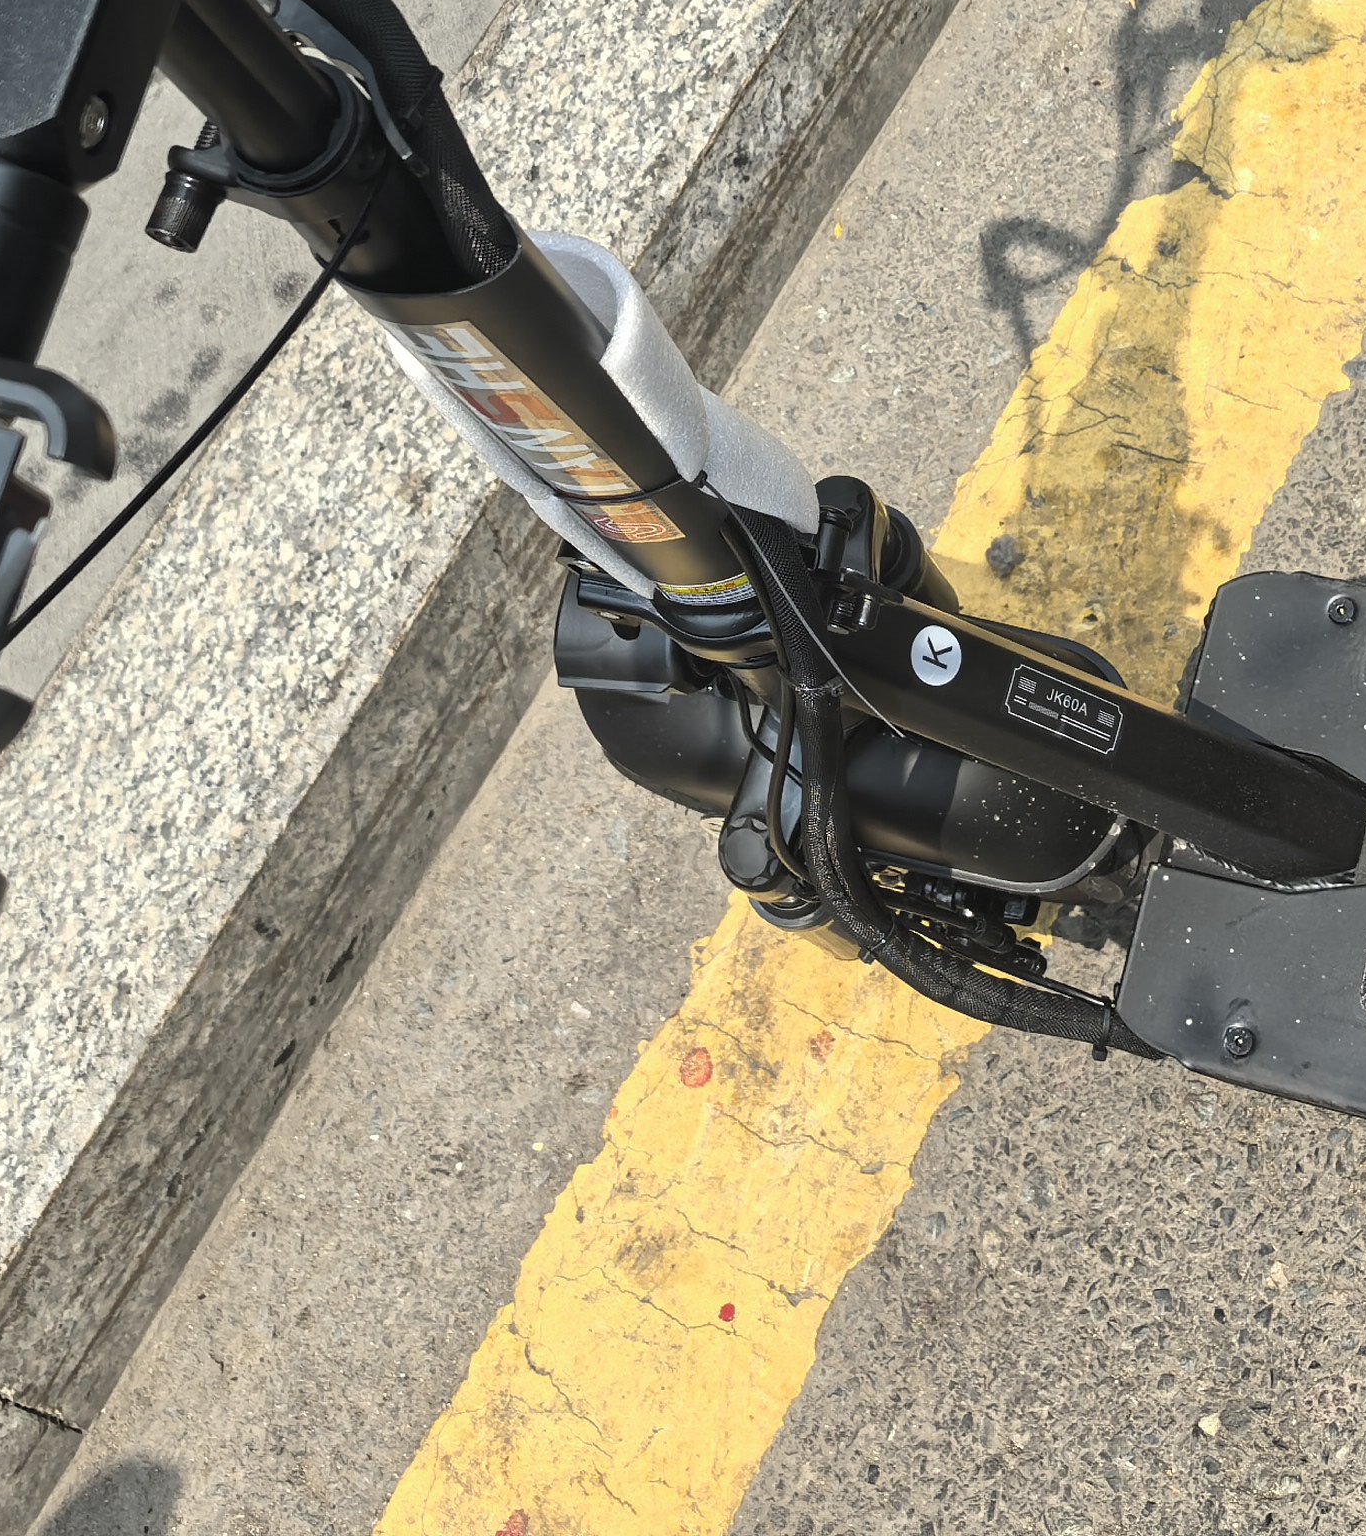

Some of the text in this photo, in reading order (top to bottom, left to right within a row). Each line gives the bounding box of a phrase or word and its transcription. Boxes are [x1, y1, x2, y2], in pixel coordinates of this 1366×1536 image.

[379, 324, 644, 511] IANSHE
[922, 636, 953, 670] K
[1046, 688, 1088, 716] JK60A
